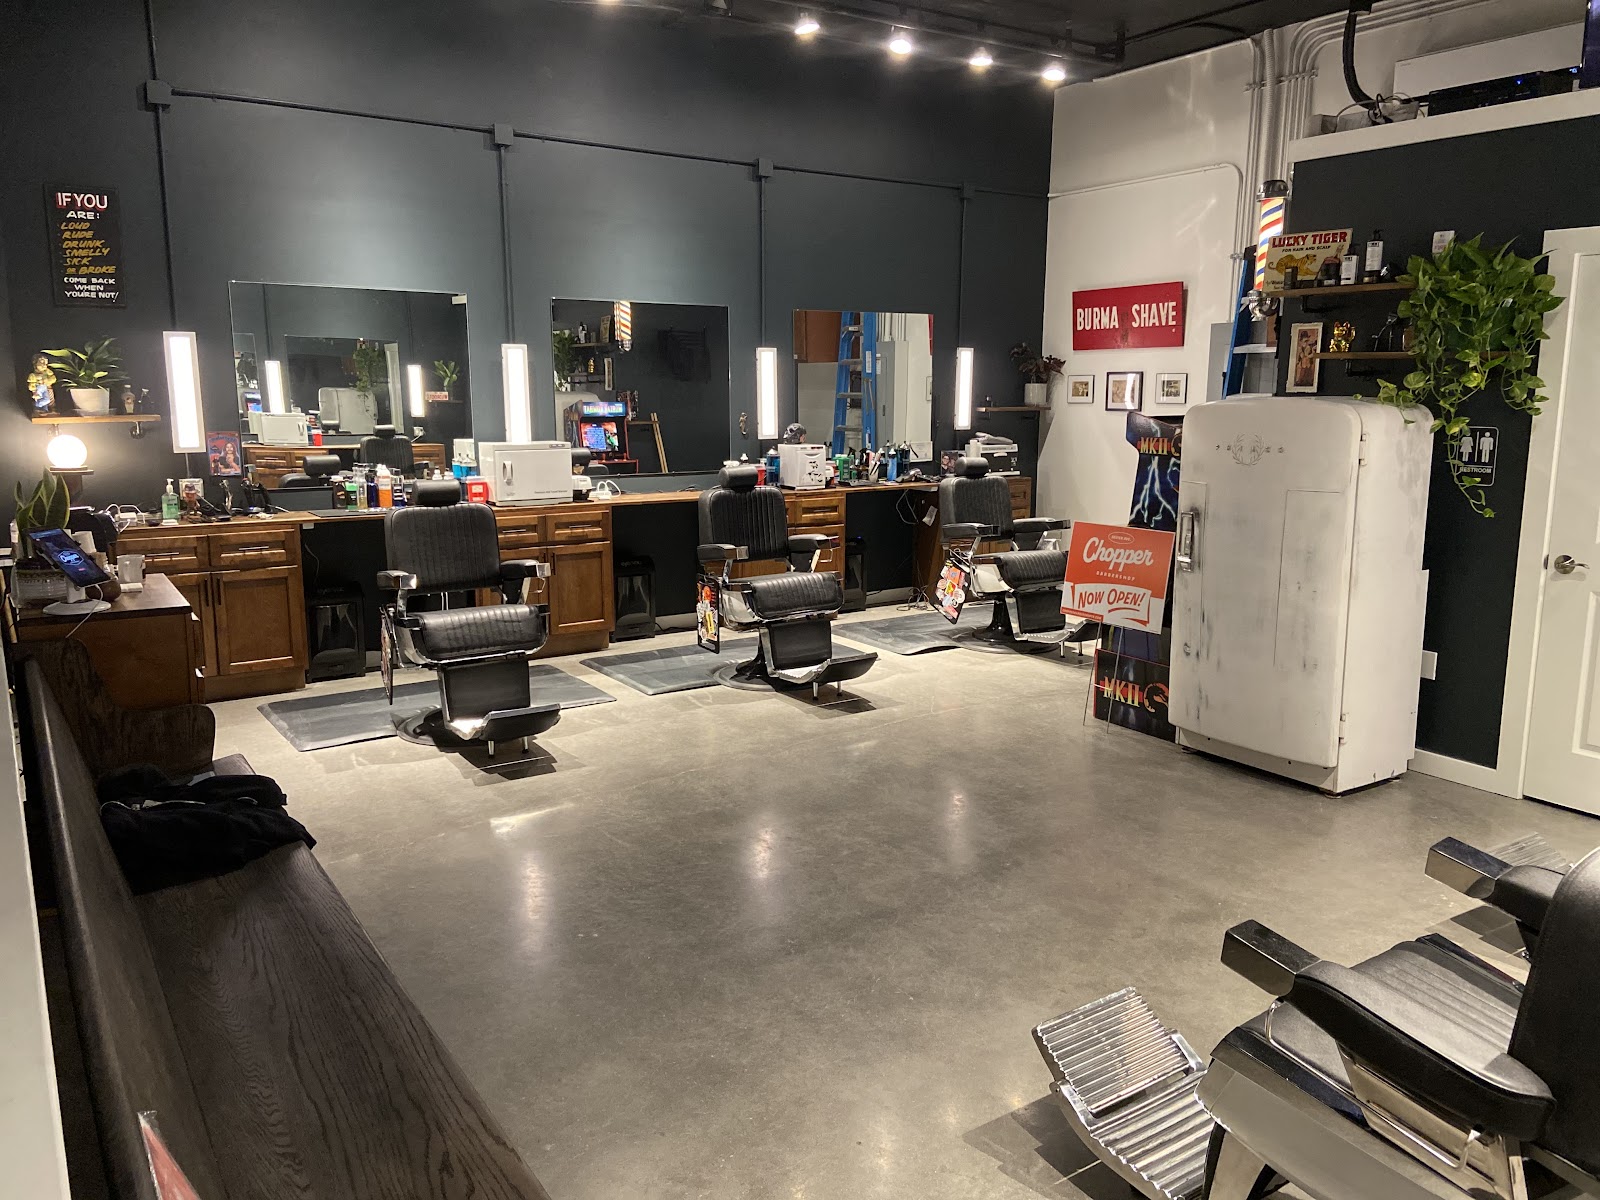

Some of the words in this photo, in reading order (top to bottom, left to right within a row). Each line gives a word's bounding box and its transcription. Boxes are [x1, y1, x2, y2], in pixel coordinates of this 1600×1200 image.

[57, 192, 72, 207] IF
[73, 193, 108, 210] YOU
[61, 222, 91, 230] LOUD
[62, 231, 94, 239] RUDE
[1272, 234, 1309, 249] LUCKY
[1311, 231, 1348, 245] TIGER
[63, 240, 105, 249] DRUNK
[63, 247, 110, 257] SMELLY
[63, 257, 92, 266] SICK
[79, 265, 116, 275] BROKE
[91, 277, 116, 285] BACK
[98, 291, 119, 303] NOT!
[1076, 305, 1119, 331] BURMA
[1131, 301, 1177, 328] SHAVE
[1140, 436, 1168, 455] MKII
[1082, 536, 1154, 572] Chopper
[1096, 570, 1136, 581] BARBERSHOP
[1078, 590, 1105, 609] NOW
[1107, 588, 1146, 607] OPEN!
[1103, 675, 1140, 708] MKII
